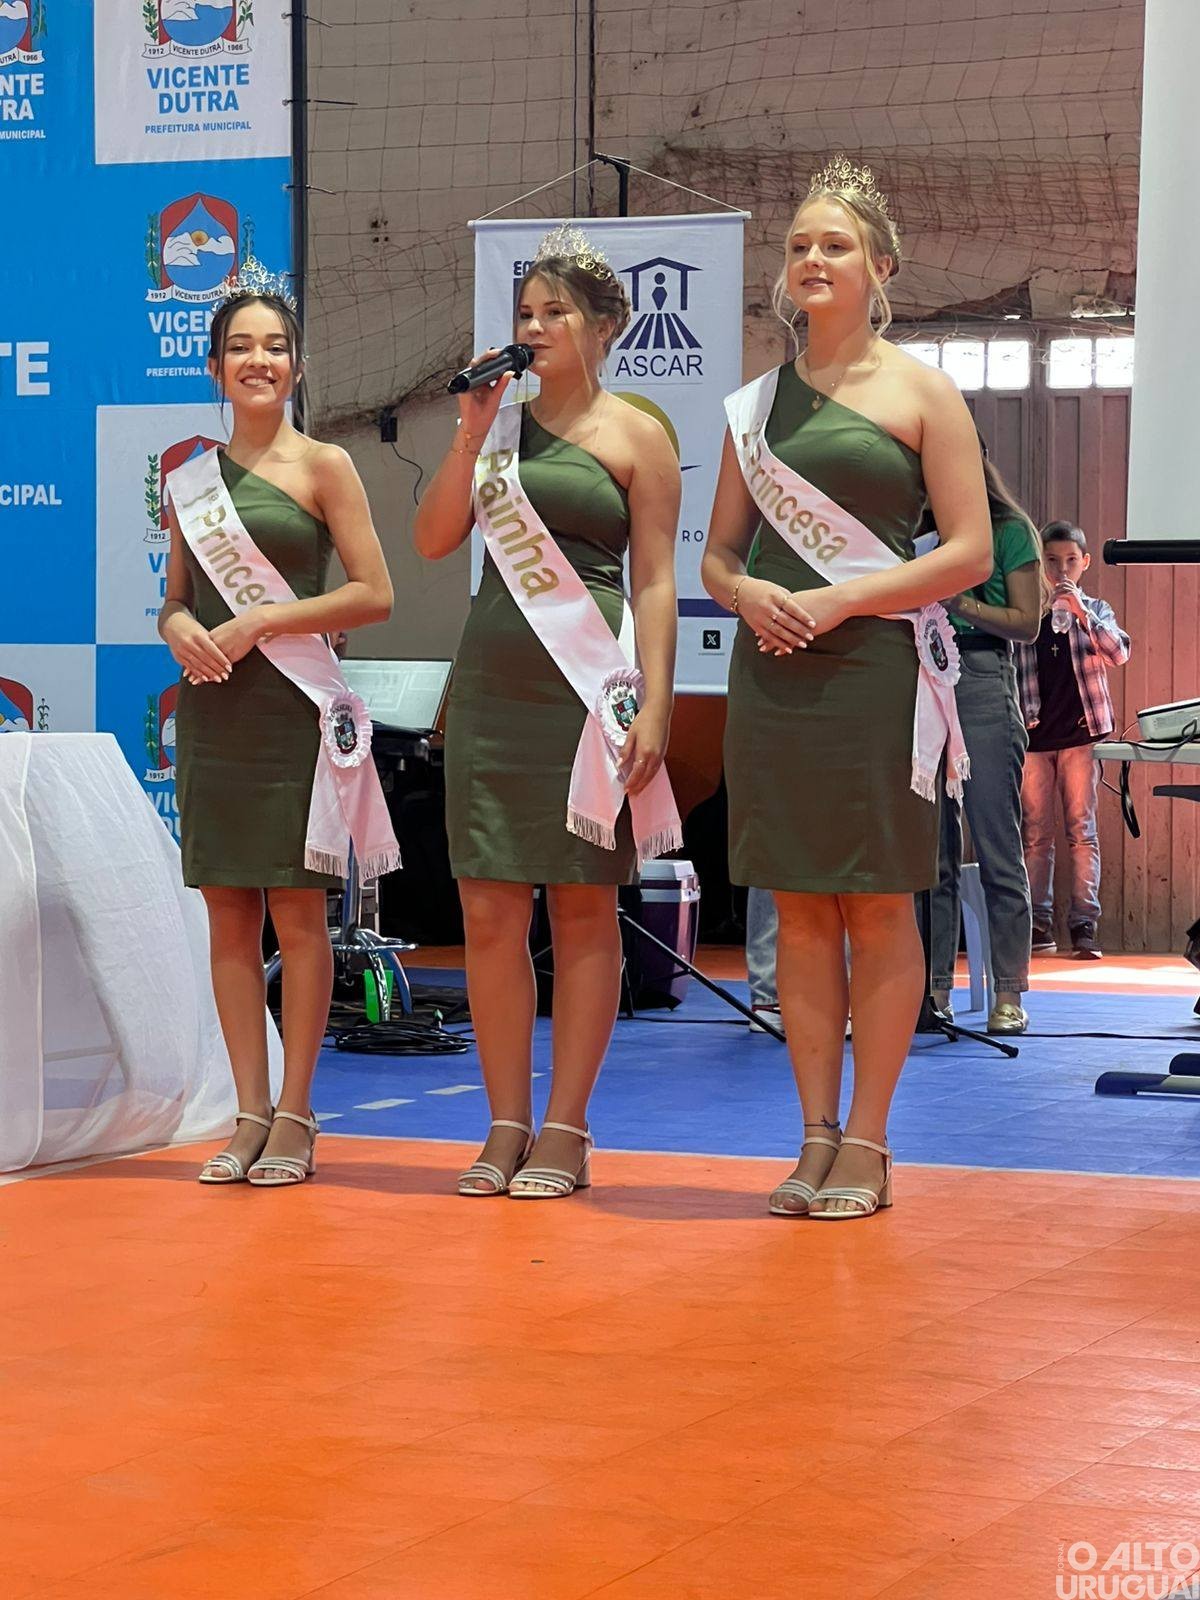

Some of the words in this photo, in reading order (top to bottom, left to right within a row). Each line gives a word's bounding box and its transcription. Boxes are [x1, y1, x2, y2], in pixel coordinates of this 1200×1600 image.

[172, 45, 198, 55] VICENTE
[200, 43, 221, 55] DUTRA
[146, 63, 250, 89] VICENTE
[0, 98, 35, 121] RA
[159, 89, 240, 114] DUTRA
[145, 123, 200, 134] PREFEITURA
[203, 121, 252, 131] MUNICIPAL
[175, 289, 201, 301] VICENTE
[160, 335, 212, 358] DUT
[146, 367, 202, 377] PREFEITURA
[615, 354, 703, 377] ASCAR
[188, 504, 275, 605] Prince
